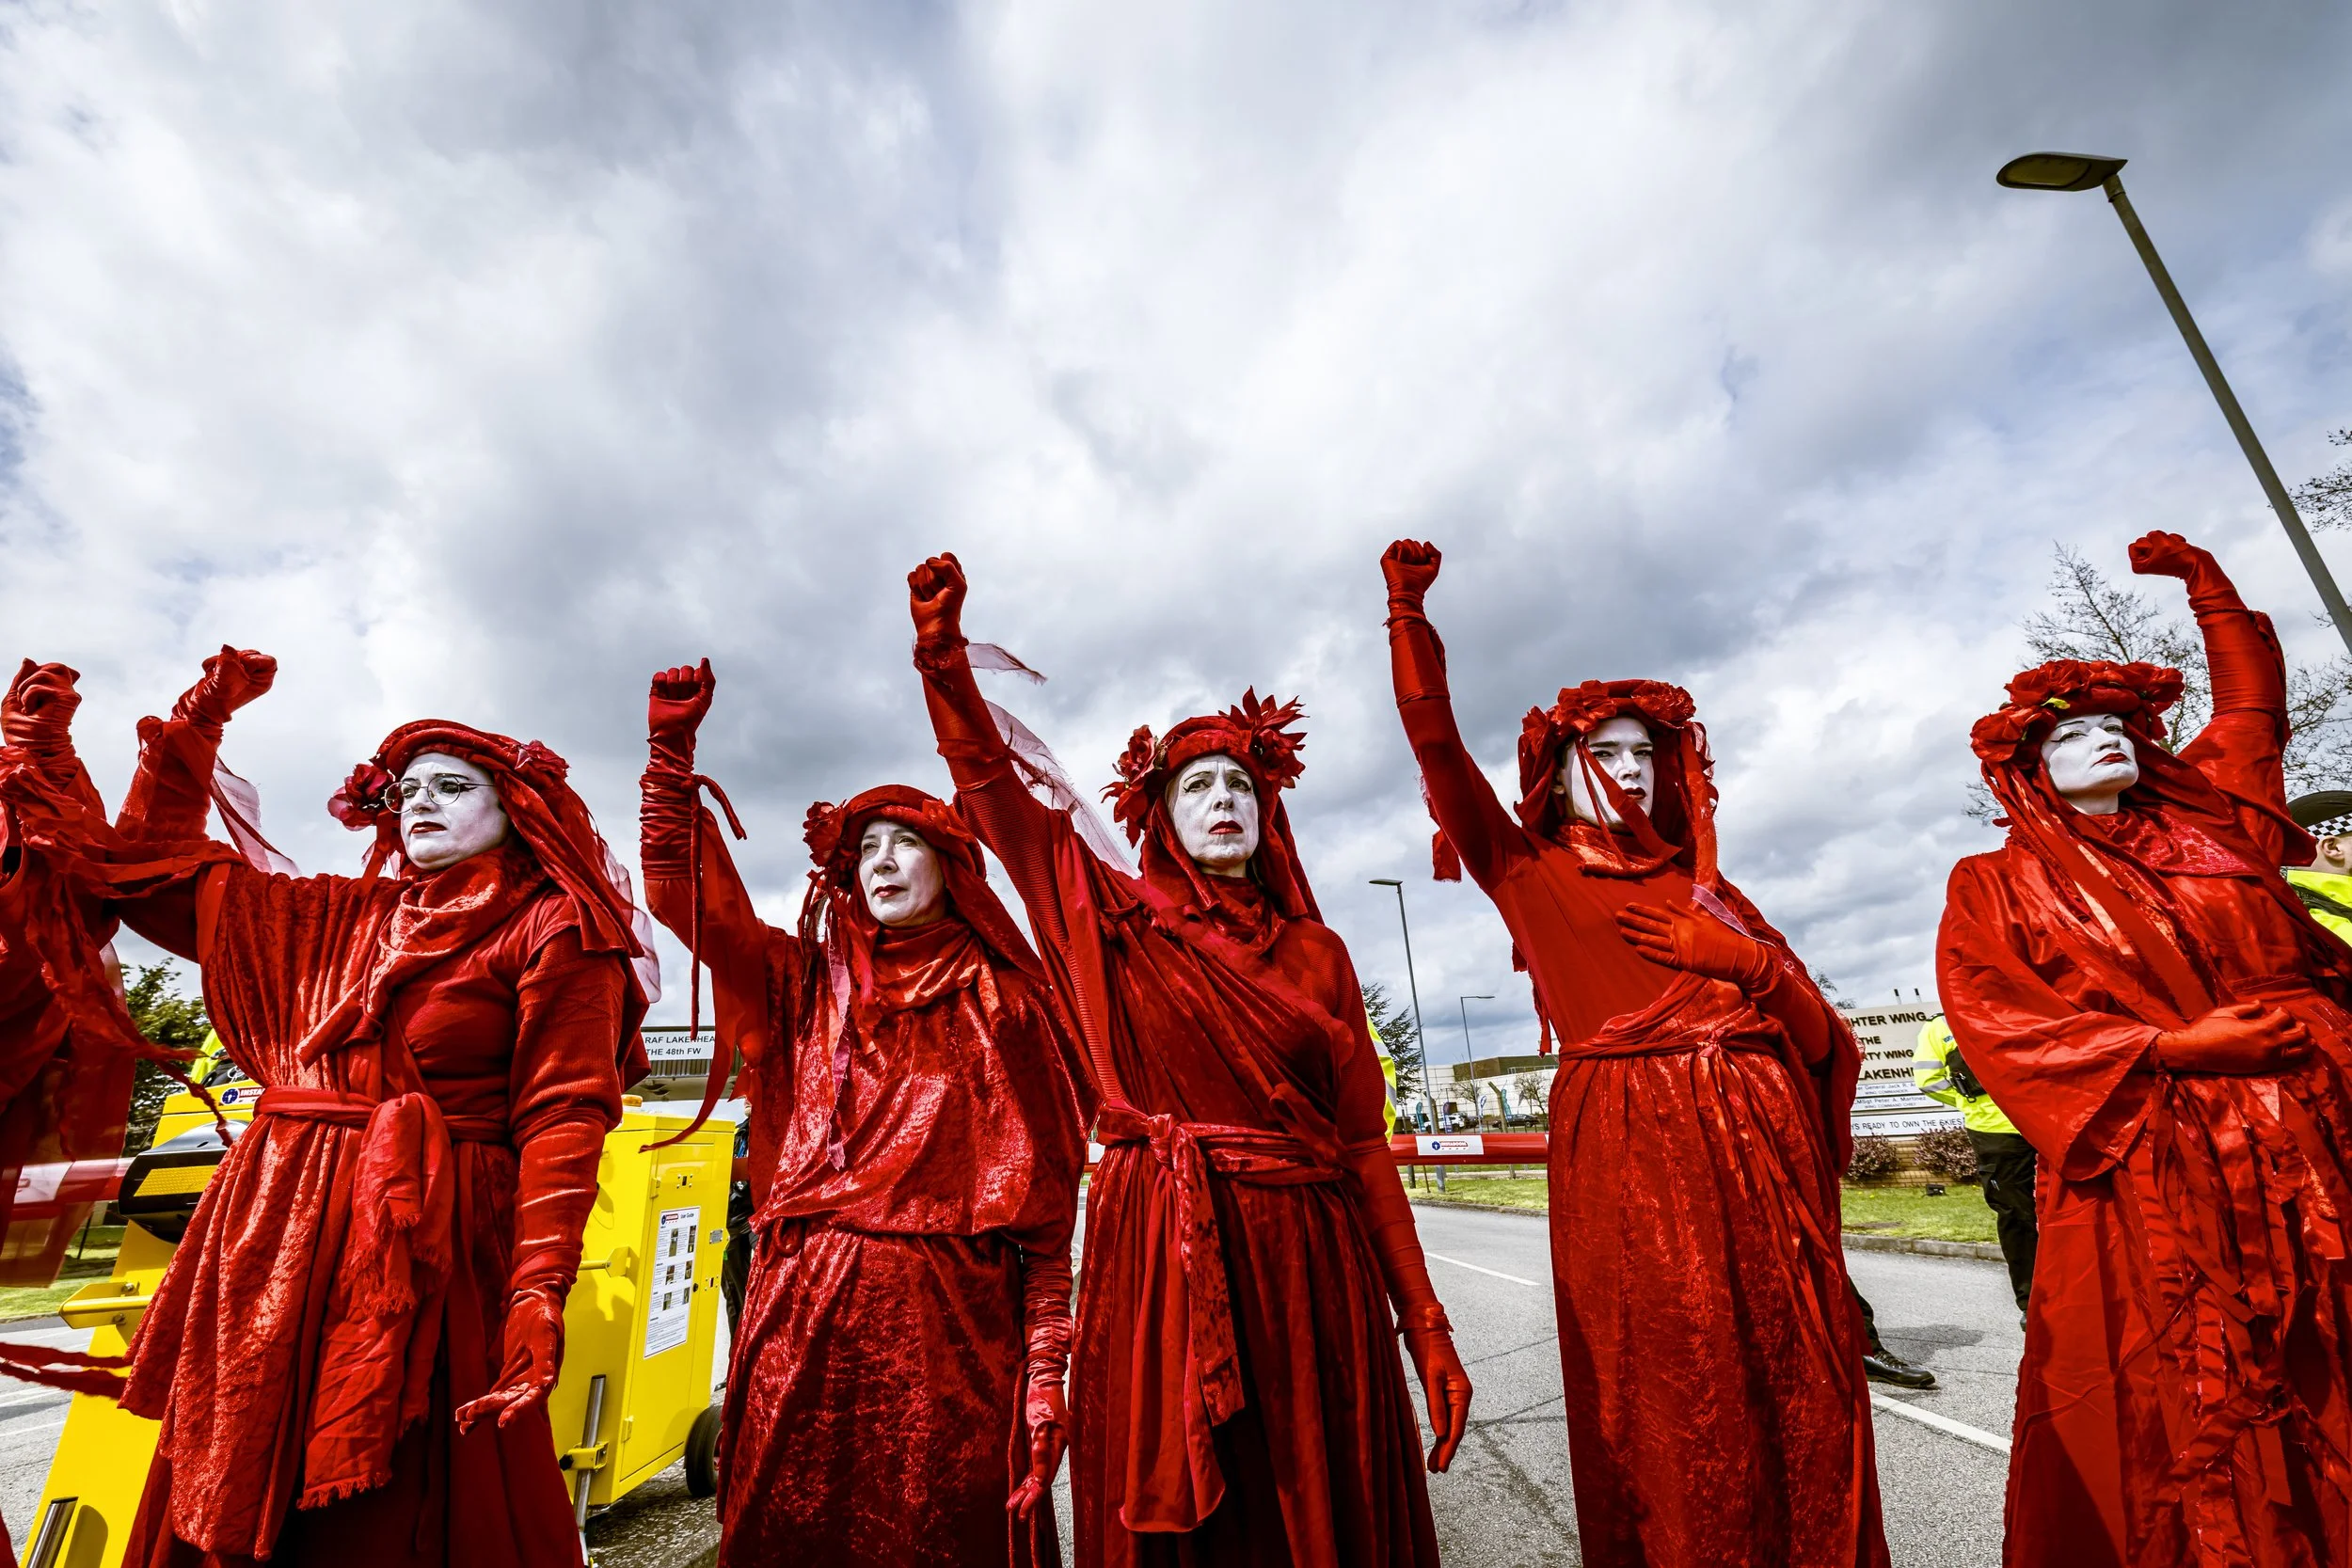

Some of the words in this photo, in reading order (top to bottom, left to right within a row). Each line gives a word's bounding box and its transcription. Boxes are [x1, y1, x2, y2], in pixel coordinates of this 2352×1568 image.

[1889, 1011, 1926, 1023] WING
[1860, 1036, 1882, 1045] THE
[1883, 1049, 1914, 1060] WING
